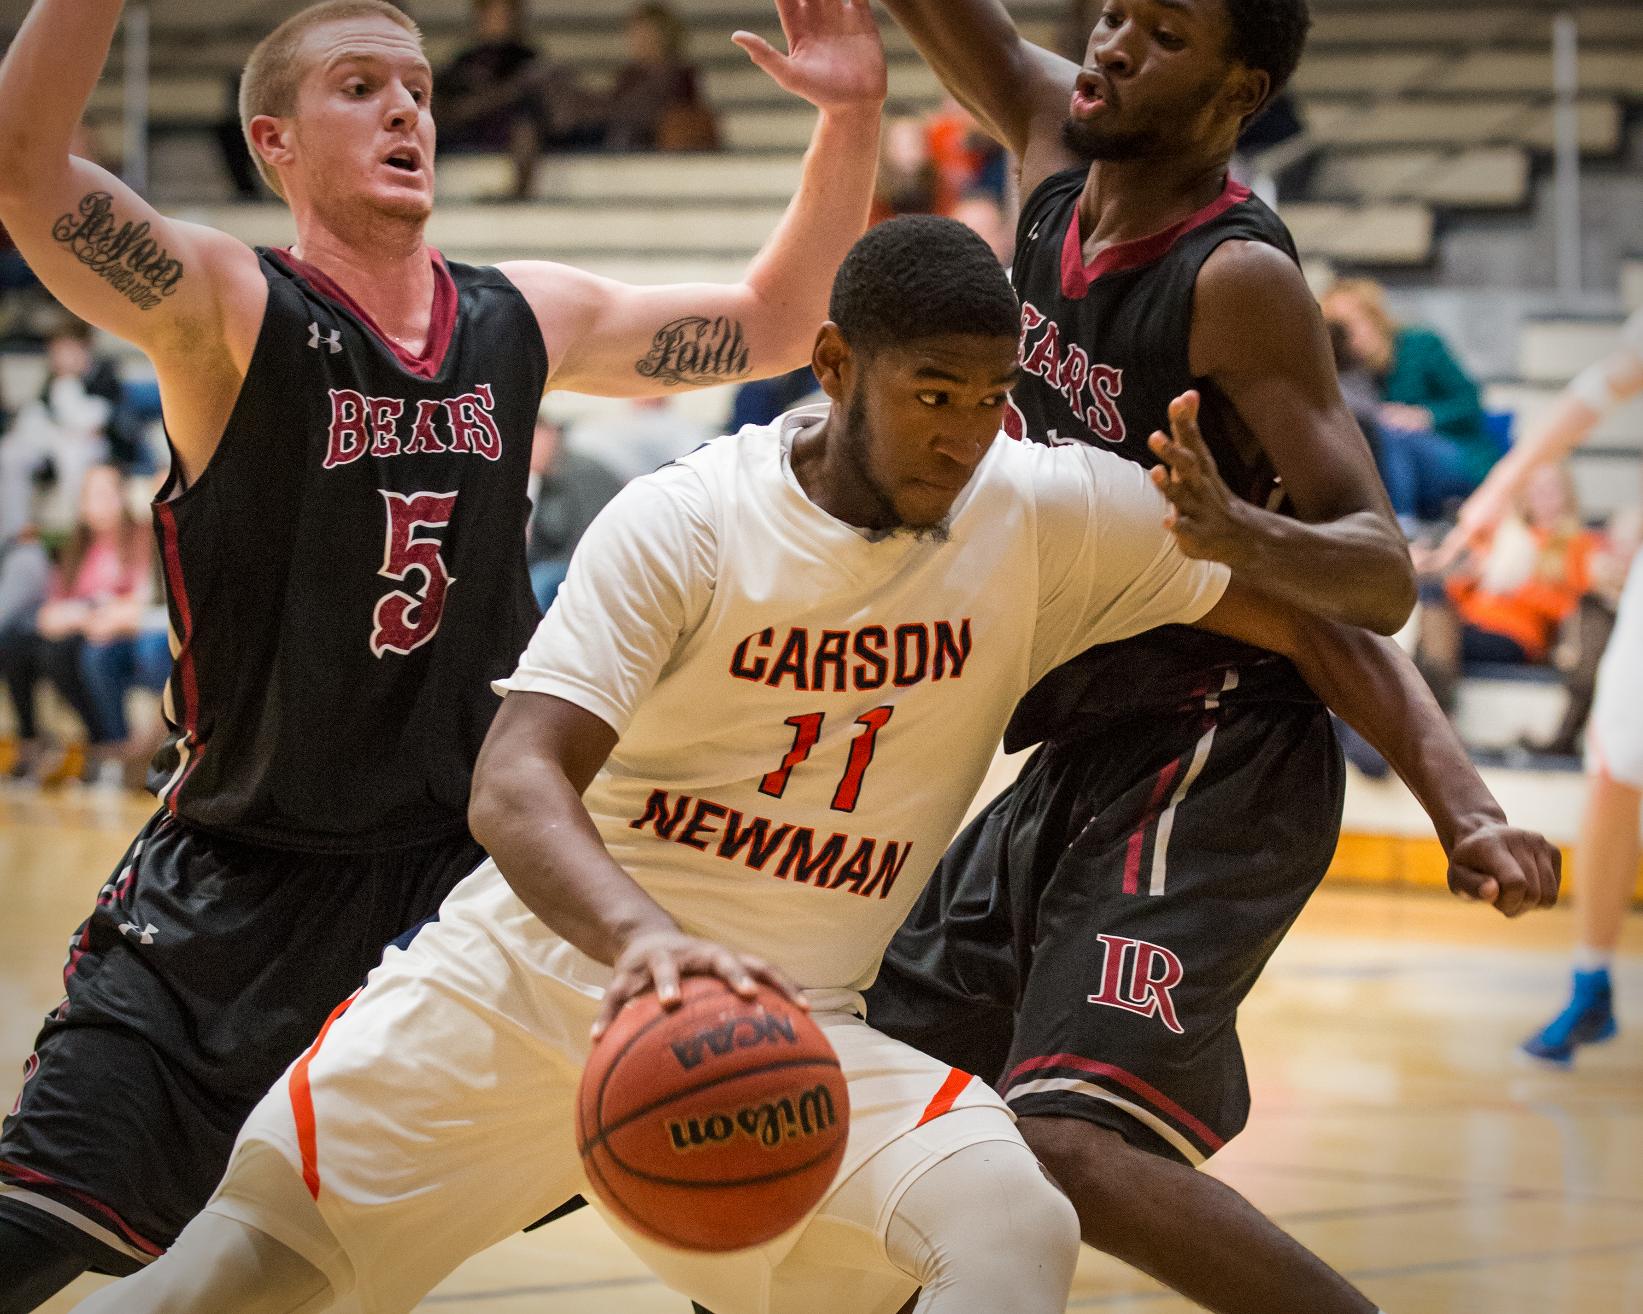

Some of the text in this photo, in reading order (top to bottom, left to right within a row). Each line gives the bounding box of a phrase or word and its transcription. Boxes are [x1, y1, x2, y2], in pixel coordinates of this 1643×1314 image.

[635, 316, 753, 386] Faith
[323, 384, 502, 469] BEARS
[369, 489, 459, 659] 5
[729, 618, 972, 692] CARSON
[758, 705, 894, 813] 11
[628, 788, 914, 899] NEWMAN
[1087, 933, 1184, 1034] LR
[671, 1015, 796, 1069] NCAA
[669, 1084, 836, 1149] Wilson
